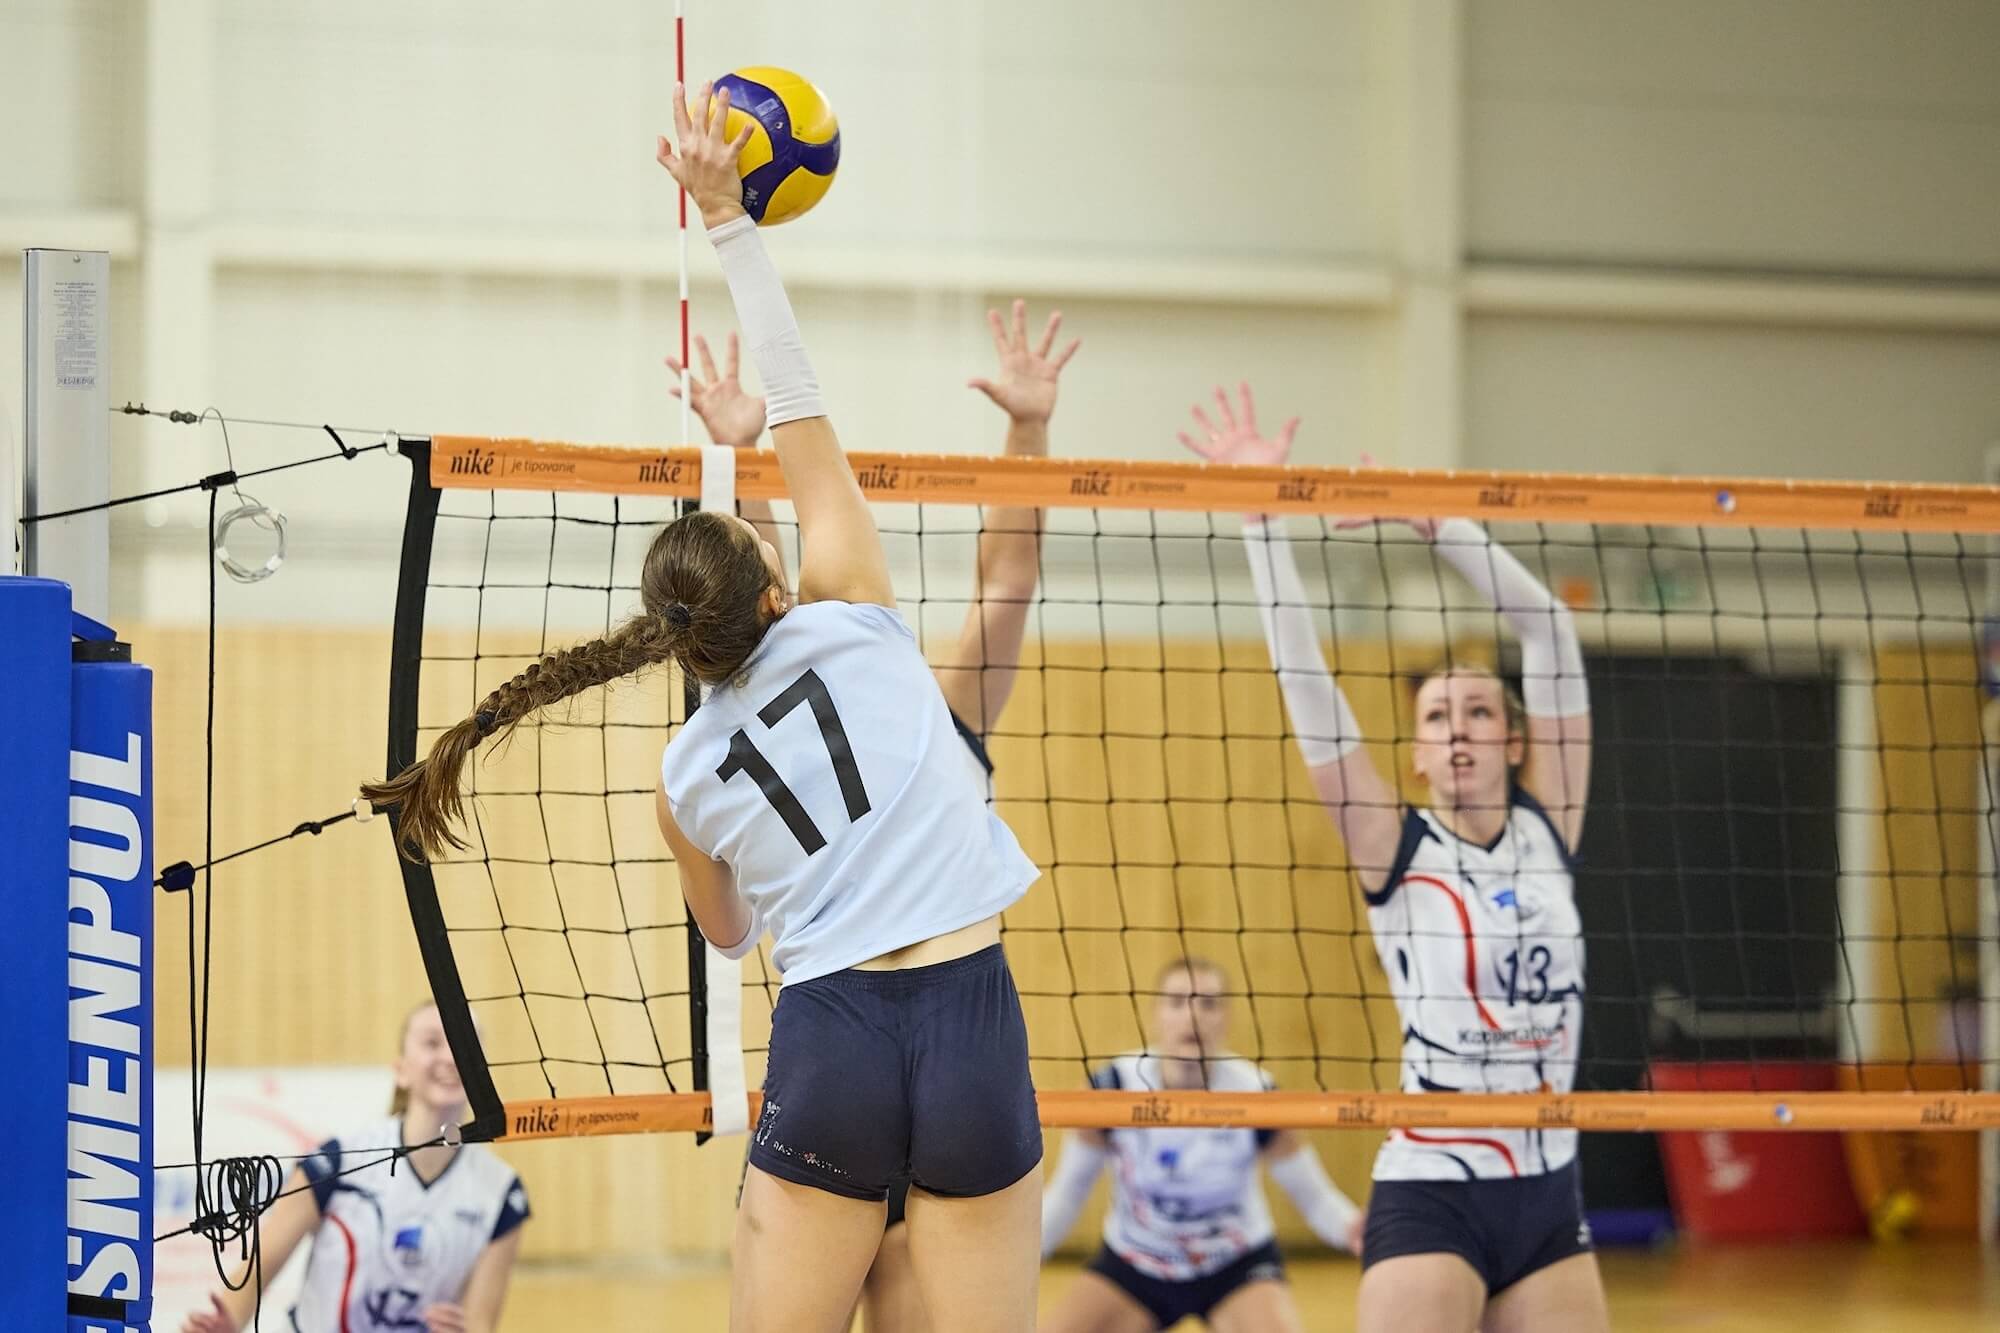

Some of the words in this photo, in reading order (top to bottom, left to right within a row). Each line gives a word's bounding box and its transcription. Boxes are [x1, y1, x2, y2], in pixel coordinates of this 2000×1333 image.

[451, 448, 495, 475] niké
[511, 460, 522, 474] je
[524, 460, 576, 475] tipovanie
[639, 455, 682, 483] niké
[859, 463, 899, 489] niké
[715, 667, 872, 857] 17
[1504, 945, 1552, 1007] 13
[67, 732, 142, 1333] SMENPUL
[516, 1106, 560, 1134] niké
[576, 1113, 586, 1127] je
[588, 1111, 640, 1126] tipovanie
